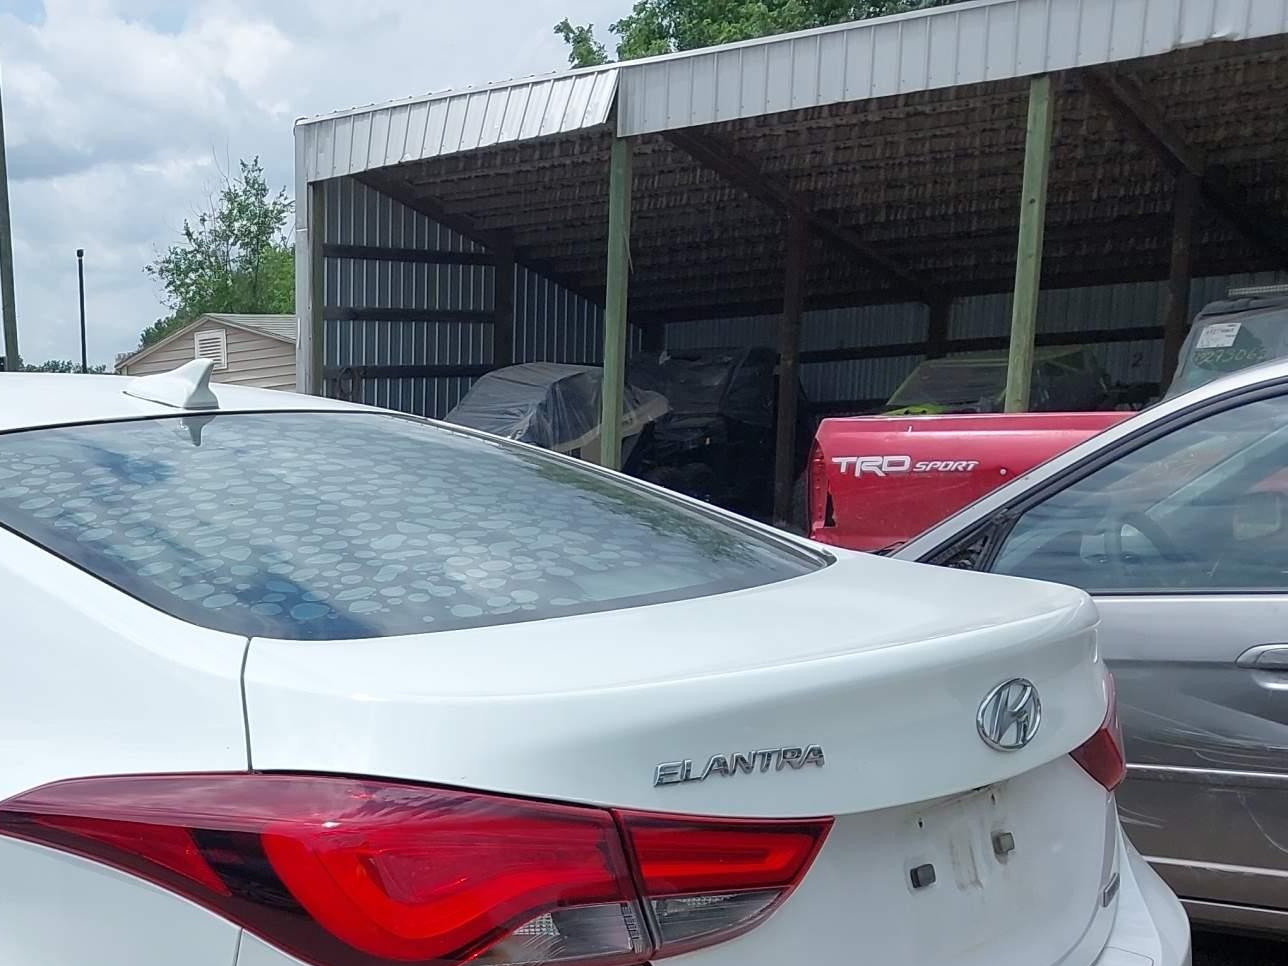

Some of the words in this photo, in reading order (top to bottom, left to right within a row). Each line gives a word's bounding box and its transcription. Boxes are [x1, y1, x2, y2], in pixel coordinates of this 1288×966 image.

[831, 455, 912, 478] TRD
[913, 460, 980, 472] SPORT
[653, 744, 825, 788] ELANTRA
